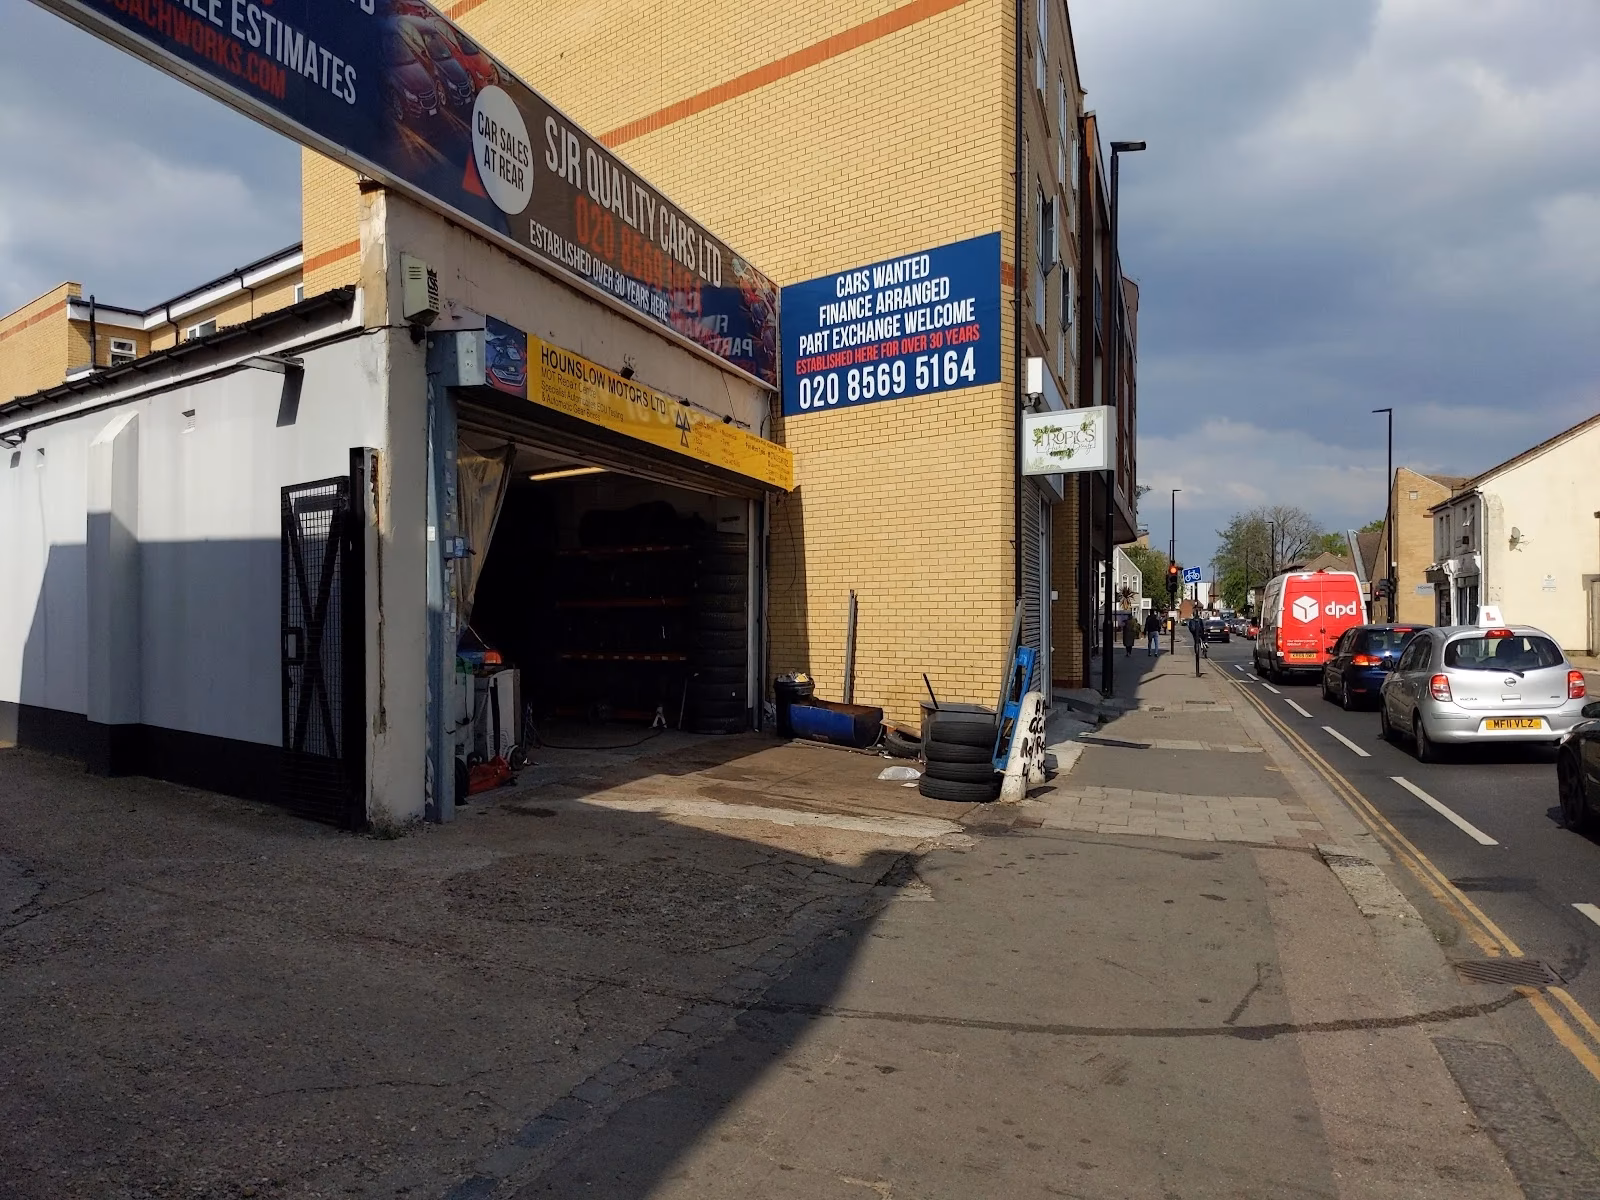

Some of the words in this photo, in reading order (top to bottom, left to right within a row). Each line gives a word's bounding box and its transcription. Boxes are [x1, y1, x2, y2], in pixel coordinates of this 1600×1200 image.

[231, 0, 357, 105] ESTIMATES
[478, 111, 498, 146] CAR
[500, 127, 529, 168] SALES
[484, 145, 497, 173] AT
[499, 154, 524, 192] REAR
[545, 116, 582, 190] SJR
[586, 147, 656, 241] QUALITY
[659, 204, 696, 271] CARS
[699, 234, 722, 289] LTD
[575, 195, 614, 261] 020
[530, 218, 592, 277] ESTABLISHED
[592, 257, 615, 290] OVER
[614, 271, 626, 297] 30
[626, 277, 650, 312] YEARS
[650, 292, 668, 322] HERE
[836, 270, 870, 298] CARS
[873, 254, 930, 289] WANTED
[819, 294, 873, 327] FINANCE
[875, 276, 950, 315] ARRANGED
[796, 352, 853, 375] ESTABLISHED
[854, 345, 880, 364] HERE
[880, 340, 899, 359] FOR
[901, 334, 927, 355] OVER
[929, 332, 943, 349] 30
[945, 324, 980, 345] YEARS
[799, 330, 830, 357] PART
[832, 314, 901, 350] EXCHANGE
[904, 298, 976, 335] WELCOME
[541, 366, 556, 381] MOT
[557, 373, 577, 390] Repair
[541, 345, 606, 390] HOUNSLOW
[608, 375, 649, 408] MOTORS
[650, 394, 666, 415] LTD
[546, 394, 573, 412] Automatic
[799, 372, 839, 410] 020
[847, 360, 906, 401] 8569
[915, 346, 976, 390] 5164
[1039, 428, 1095, 446] TROPICS
[1324, 601, 1357, 618] dpd
[1485, 612, 1496, 622] L
[1513, 719, 1534, 728] VLZ
